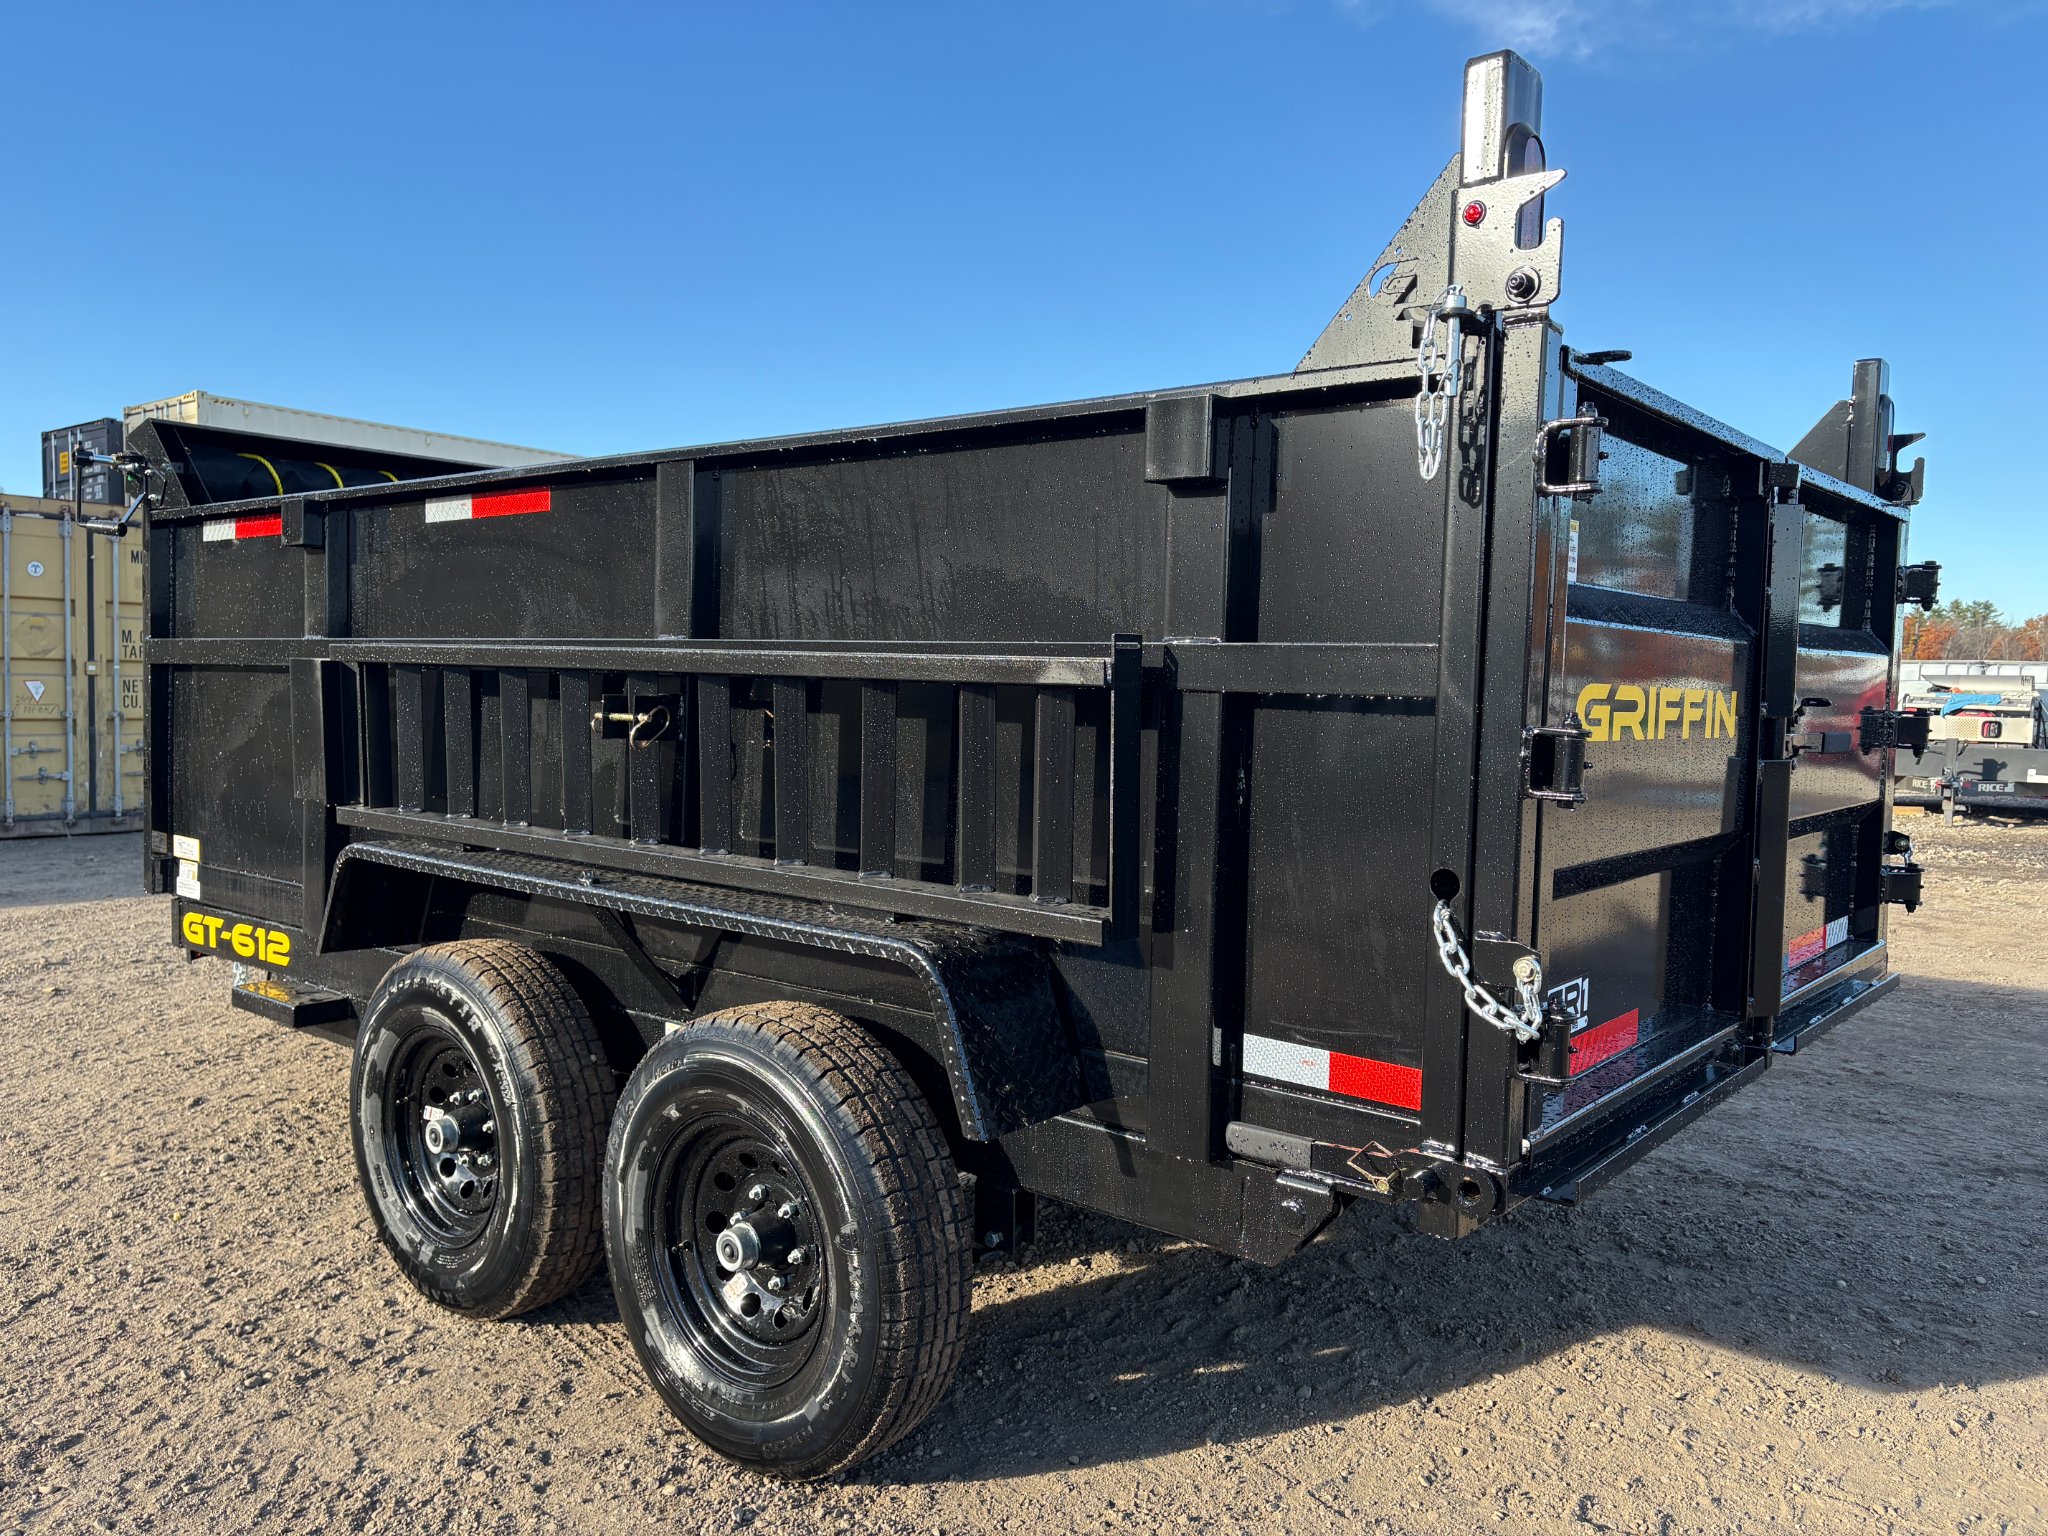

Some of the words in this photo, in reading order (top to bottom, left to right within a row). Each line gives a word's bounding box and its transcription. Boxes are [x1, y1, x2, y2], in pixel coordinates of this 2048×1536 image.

[1576, 683, 1738, 742] GRIFFIN
[1977, 783, 2004, 793] RICE
[182, 911, 291, 967] GT-612
[1548, 977, 1589, 1019] R1
